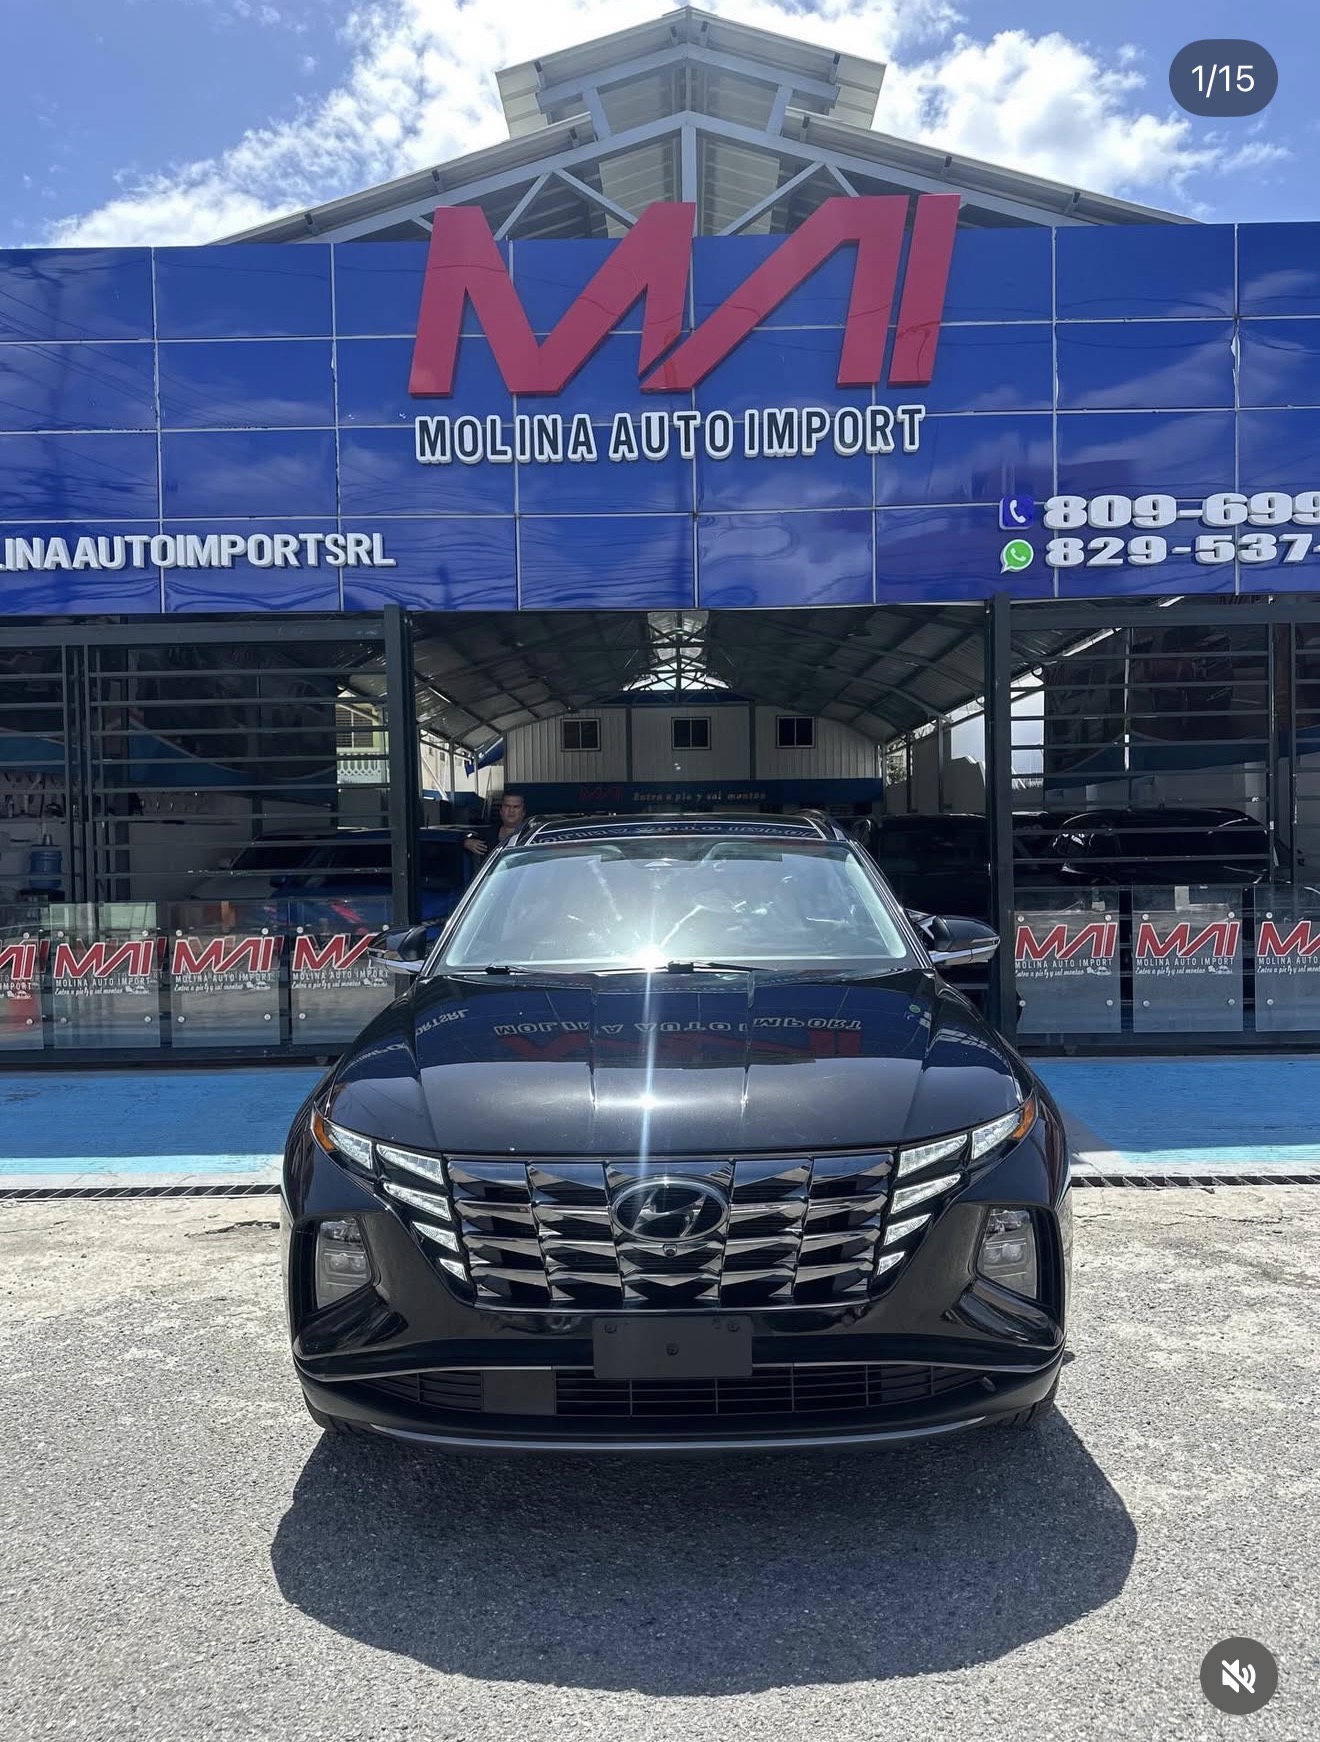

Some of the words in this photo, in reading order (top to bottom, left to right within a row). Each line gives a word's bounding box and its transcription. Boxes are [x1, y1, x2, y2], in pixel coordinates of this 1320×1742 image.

[408, 193, 961, 396] MAI
[415, 414, 597, 464] MOLINA
[608, 410, 733, 461] AUTO
[744, 405, 926, 457] IMPORT
[0, 533, 396, 571] INAAUTOIMPORTSRL
[171, 936, 274, 975] MAI
[1015, 922, 1118, 961] MAI
[1135, 922, 1240, 958] MAI
[53, 941, 154, 978] MAI
[176, 974, 208, 982] MOLINA
[213, 974, 234, 982] AUTO
[239, 972, 272, 981] IMPORT
[293, 972, 326, 980] MOLINA
[330, 971, 351, 979] AUTO
[1015, 961, 1048, 969] MOLINA
[1053, 959, 1075, 968] AUTO
[1080, 958, 1112, 967] IMPORT
[1137, 958, 1170, 966] MOLINA
[1174, 957, 1197, 966] AUTO
[1201, 957, 1234, 966] IMPORT
[1259, 957, 1291, 965] MOLINA
[1296, 956, 1318, 964] AUTO
[56, 979, 88, 987] MOLINA
[92, 978, 113, 986] AUTO
[118, 977, 151, 985] IMPORT
